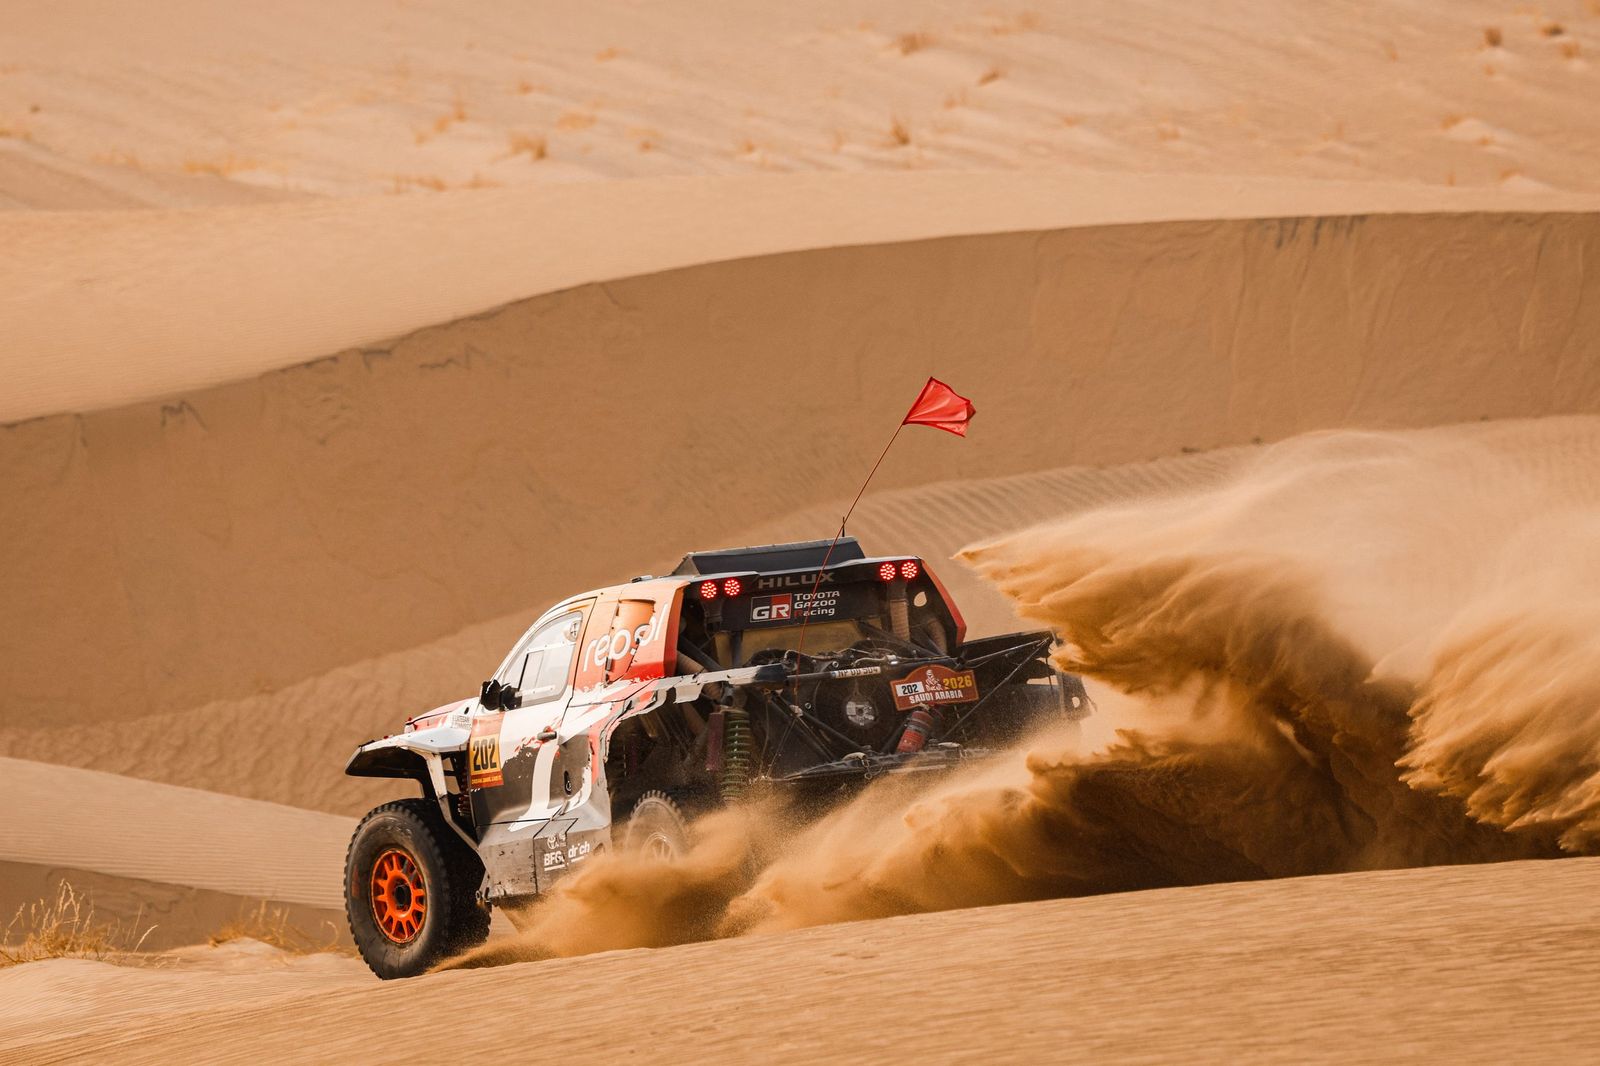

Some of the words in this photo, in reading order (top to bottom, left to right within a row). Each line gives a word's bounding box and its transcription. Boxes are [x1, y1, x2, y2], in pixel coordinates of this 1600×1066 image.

[758, 572, 835, 589] HILUX
[794, 590, 840, 601] TOYOTA
[752, 604, 790, 620] GR
[794, 599, 837, 609] GAZOO
[901, 684, 919, 695] 202
[943, 675, 973, 690] 2026
[909, 692, 934, 704] SAUDI
[935, 689, 964, 700] ARABIA
[473, 737, 498, 772] 202
